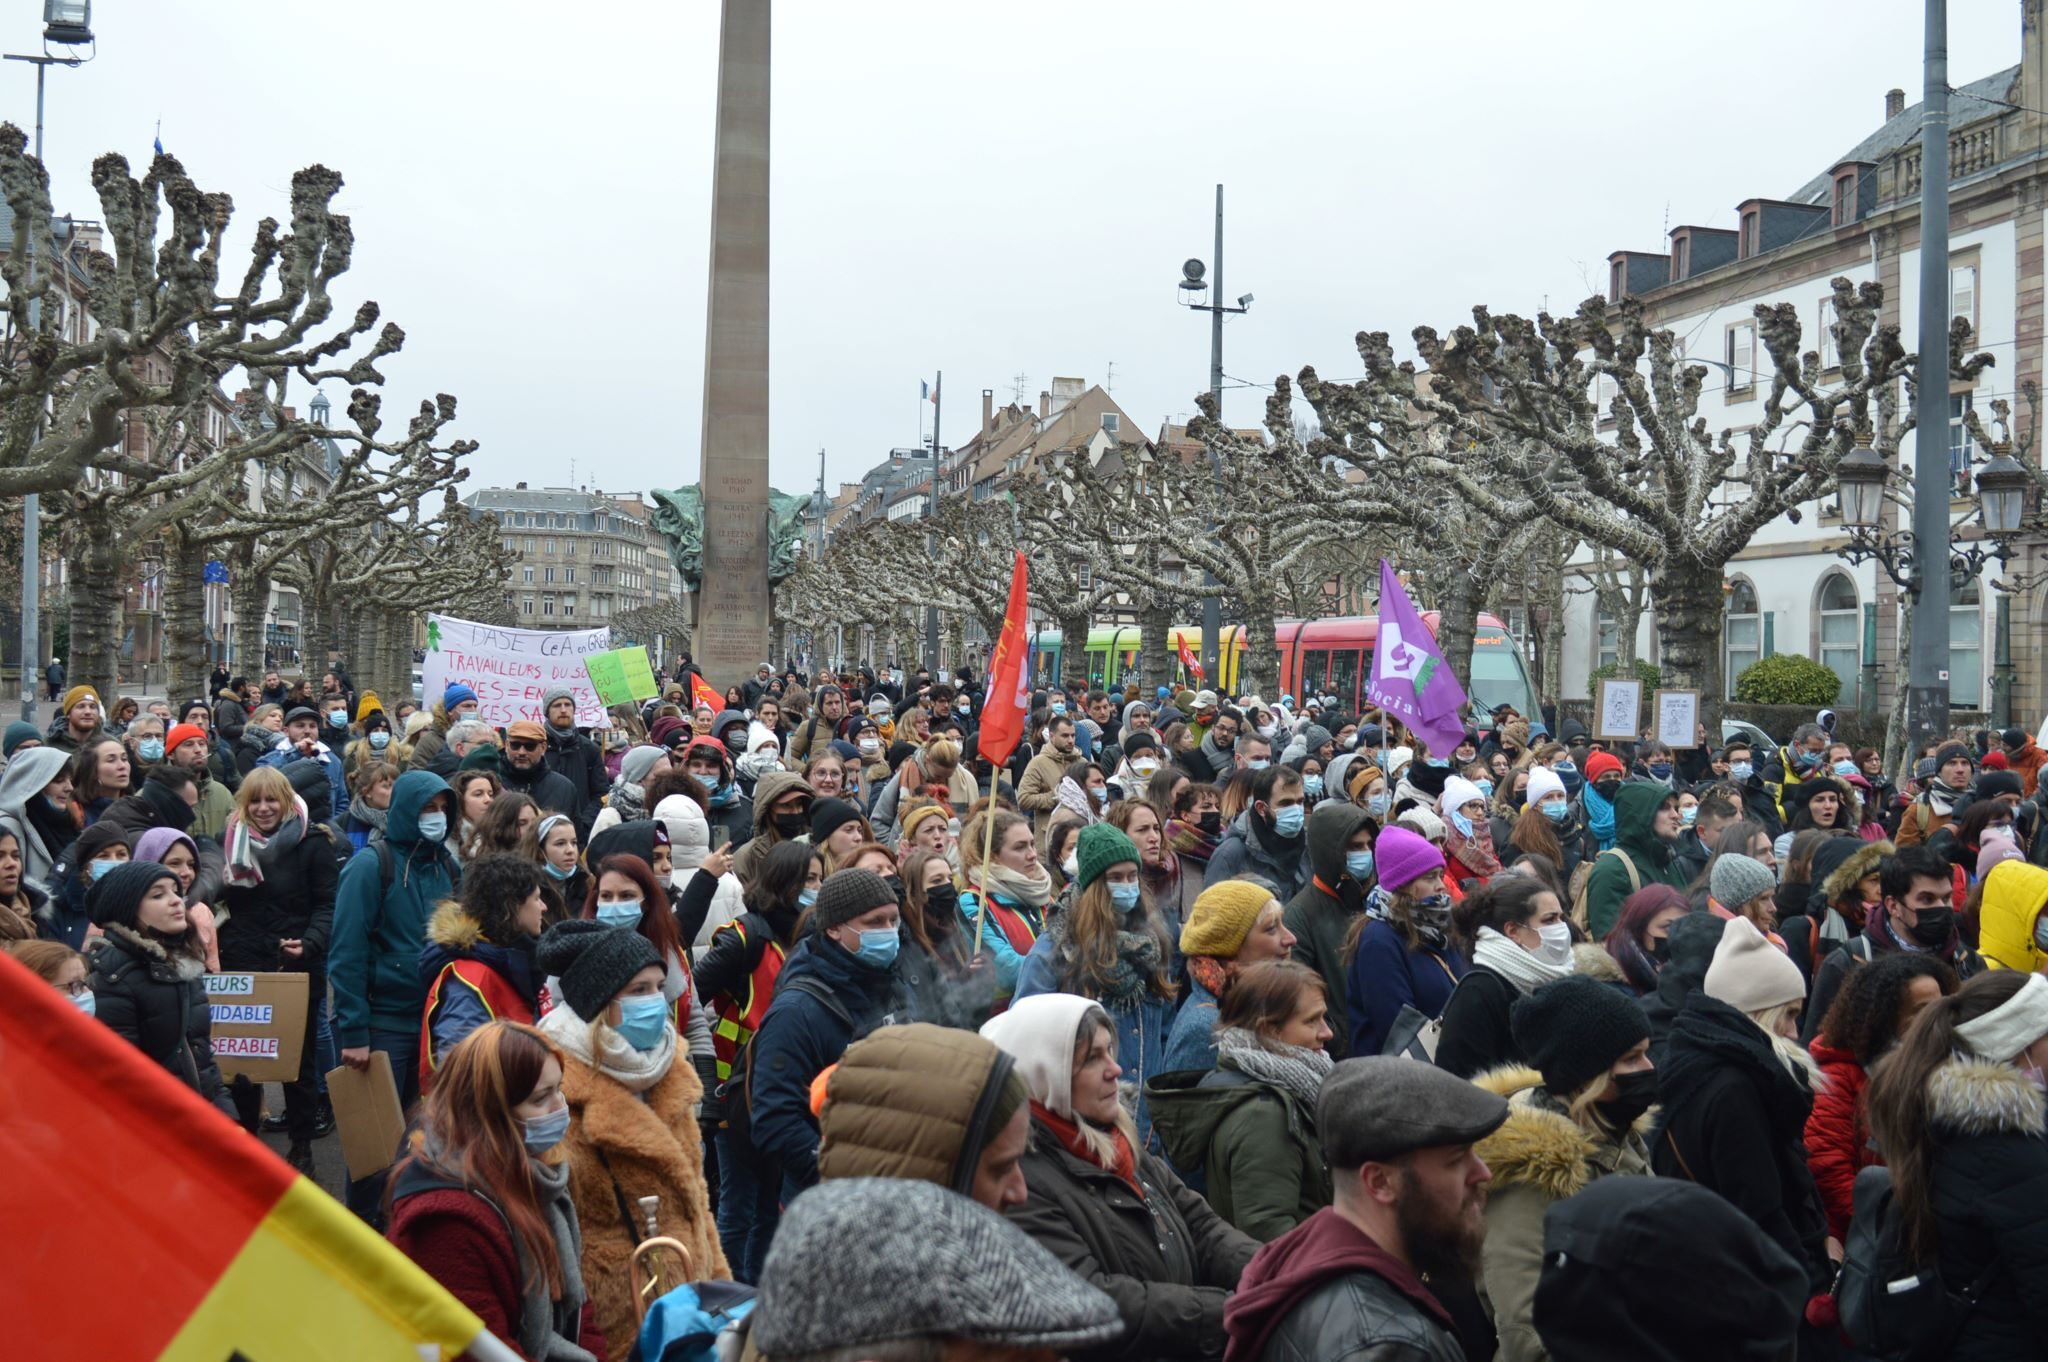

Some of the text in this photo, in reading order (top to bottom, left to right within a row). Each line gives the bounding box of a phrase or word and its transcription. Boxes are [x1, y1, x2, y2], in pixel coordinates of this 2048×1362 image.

[472, 626, 525, 652] DASE
[552, 665, 568, 680] DU
[571, 667, 588, 679] SO
[203, 976, 249, 992] TEURS
[211, 1039, 277, 1054] SERABLE
